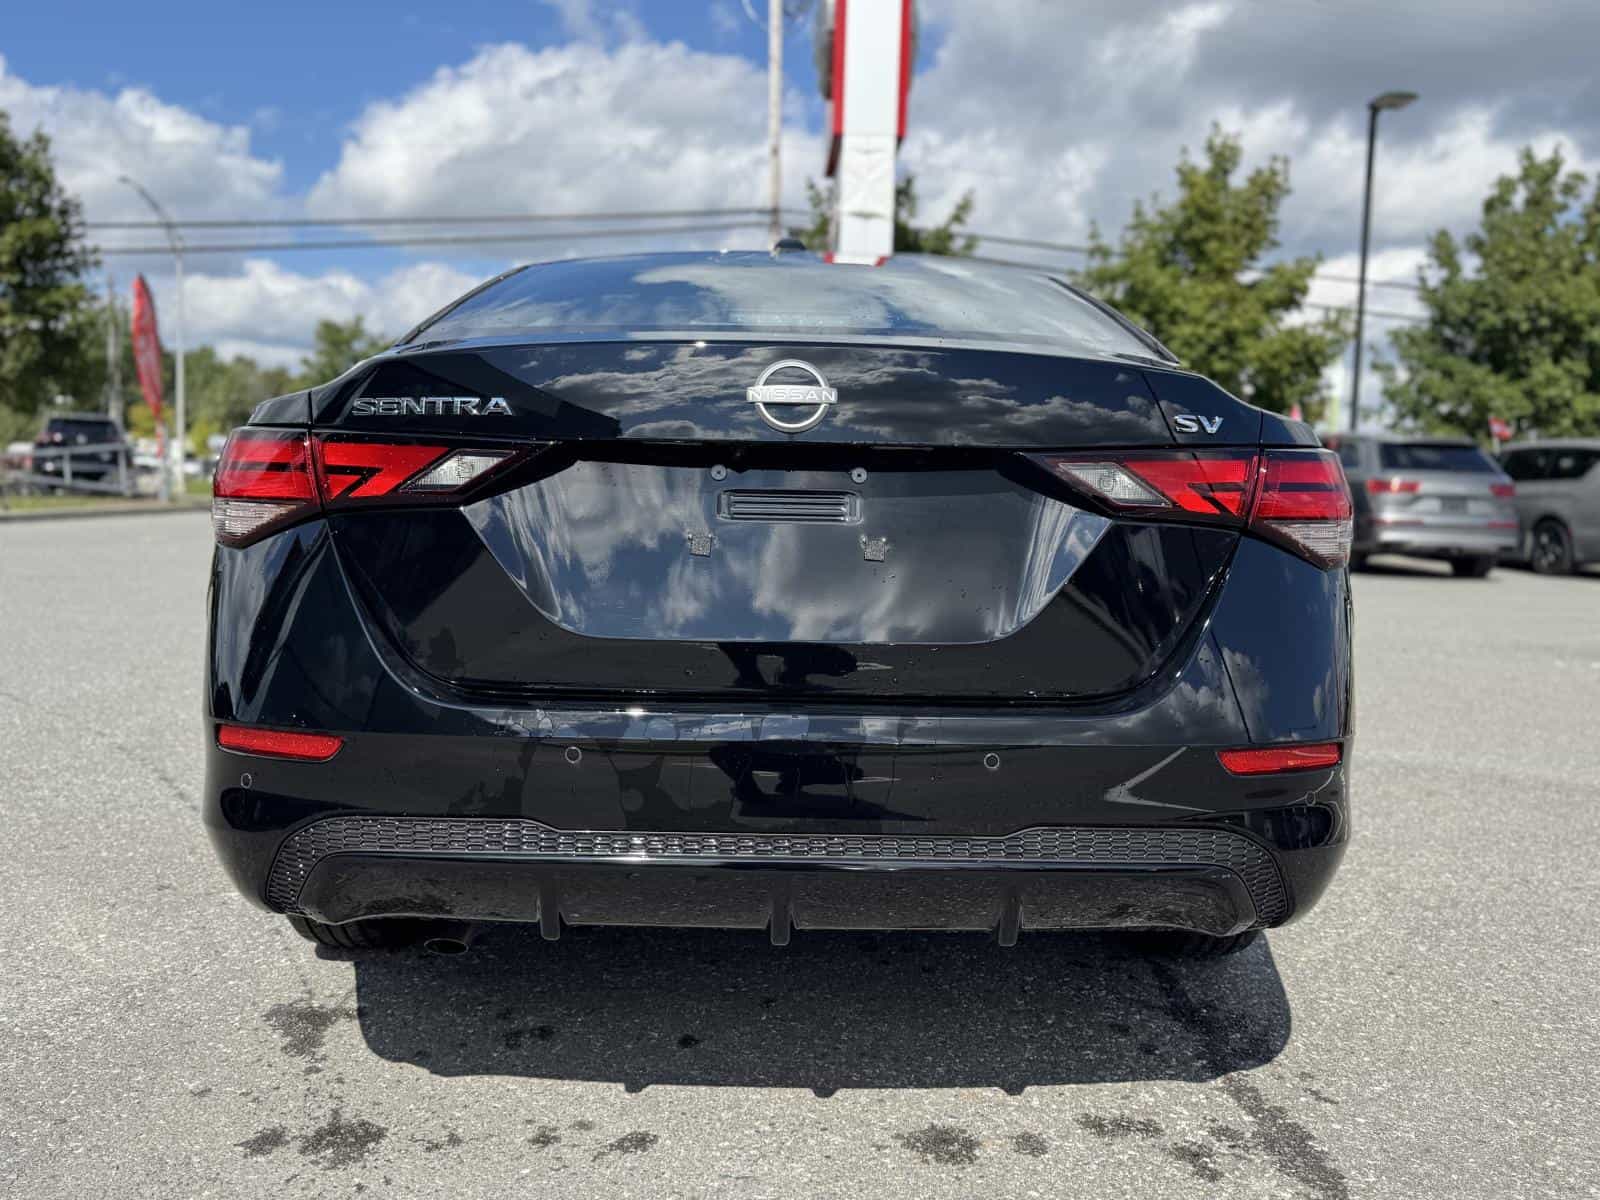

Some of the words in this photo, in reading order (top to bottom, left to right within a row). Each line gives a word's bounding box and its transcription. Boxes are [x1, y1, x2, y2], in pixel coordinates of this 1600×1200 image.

[747, 389, 836, 402] NISSAN
[352, 397, 513, 416] SENTRA
[1173, 414, 1224, 434] SV
